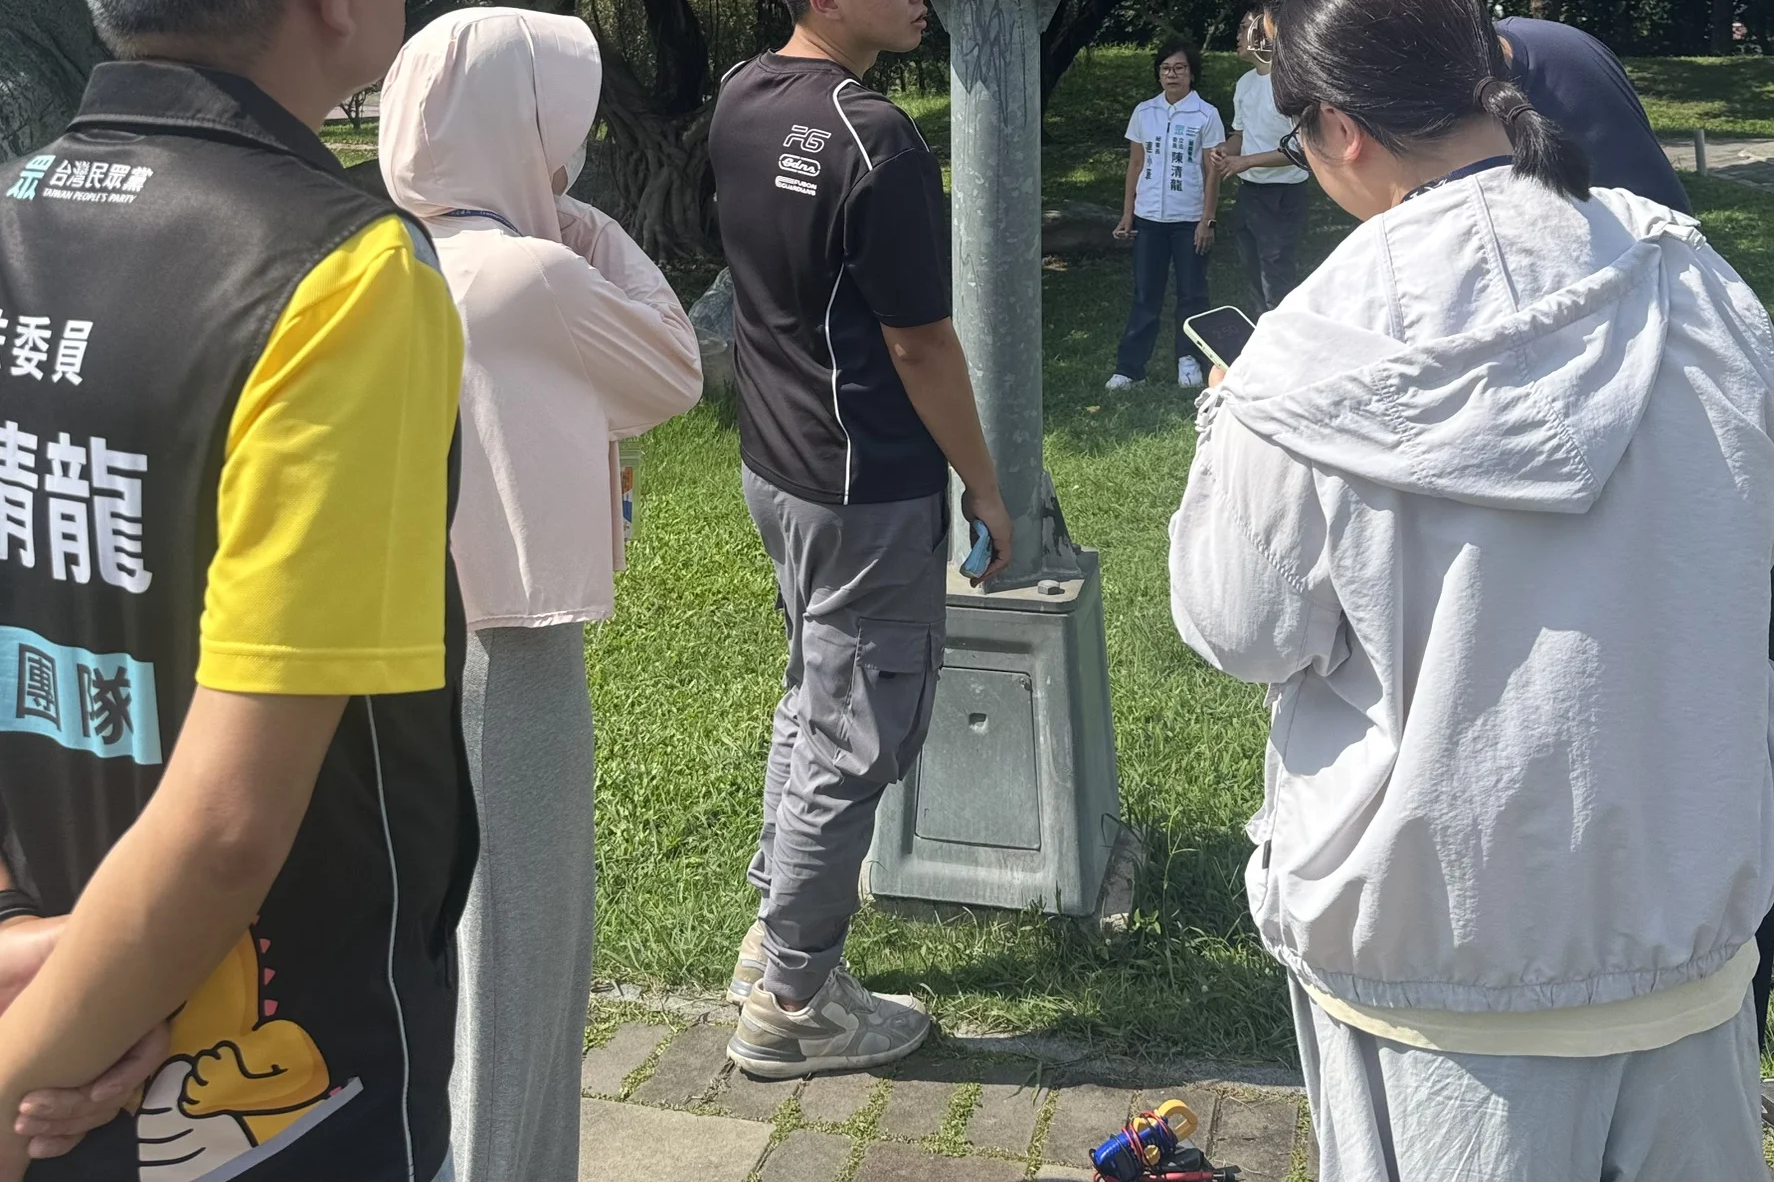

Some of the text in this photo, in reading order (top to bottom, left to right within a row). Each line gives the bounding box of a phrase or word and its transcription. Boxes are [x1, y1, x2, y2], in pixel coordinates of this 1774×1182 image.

[49, 160, 153, 192] 台灣民眾黨
[1170, 151, 1183, 191] 陳清龍
[42, 188, 137, 204] TAIWAN PEOPLE'S PARTY
[0, 308, 94, 386] 委員
[16, 642, 134, 745] 團隊
